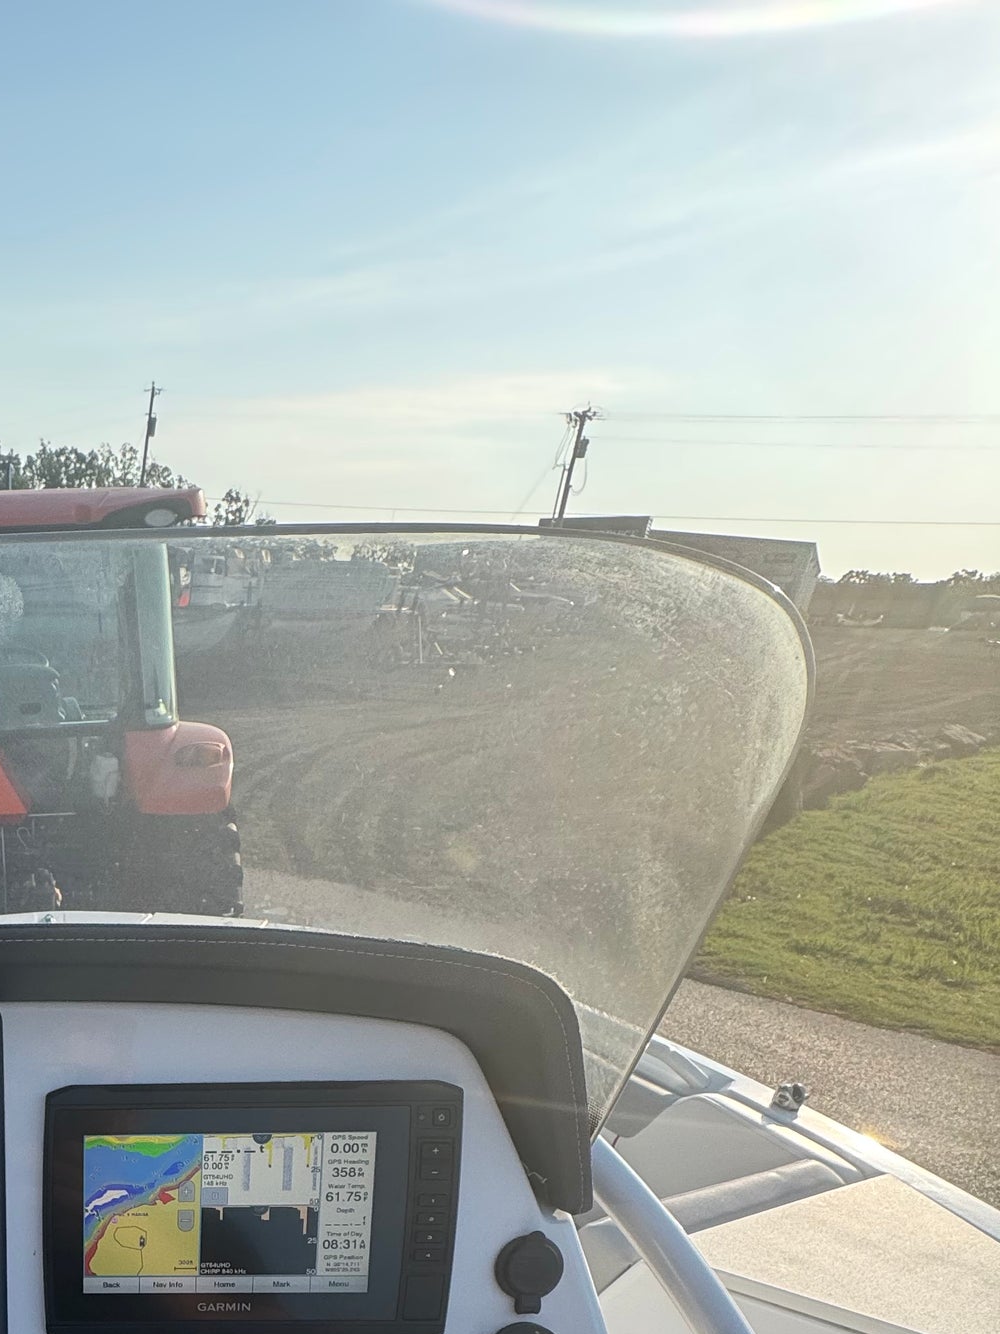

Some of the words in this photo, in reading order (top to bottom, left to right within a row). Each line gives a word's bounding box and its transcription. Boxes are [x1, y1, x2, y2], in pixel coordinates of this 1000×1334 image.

[331, 1142, 359, 1153] 0.00
[332, 1167, 356, 1178] 358
[326, 1191, 361, 1202] 61.75
[322, 1240, 357, 1250] 08:31
[197, 1302, 251, 1312] GARMIN
